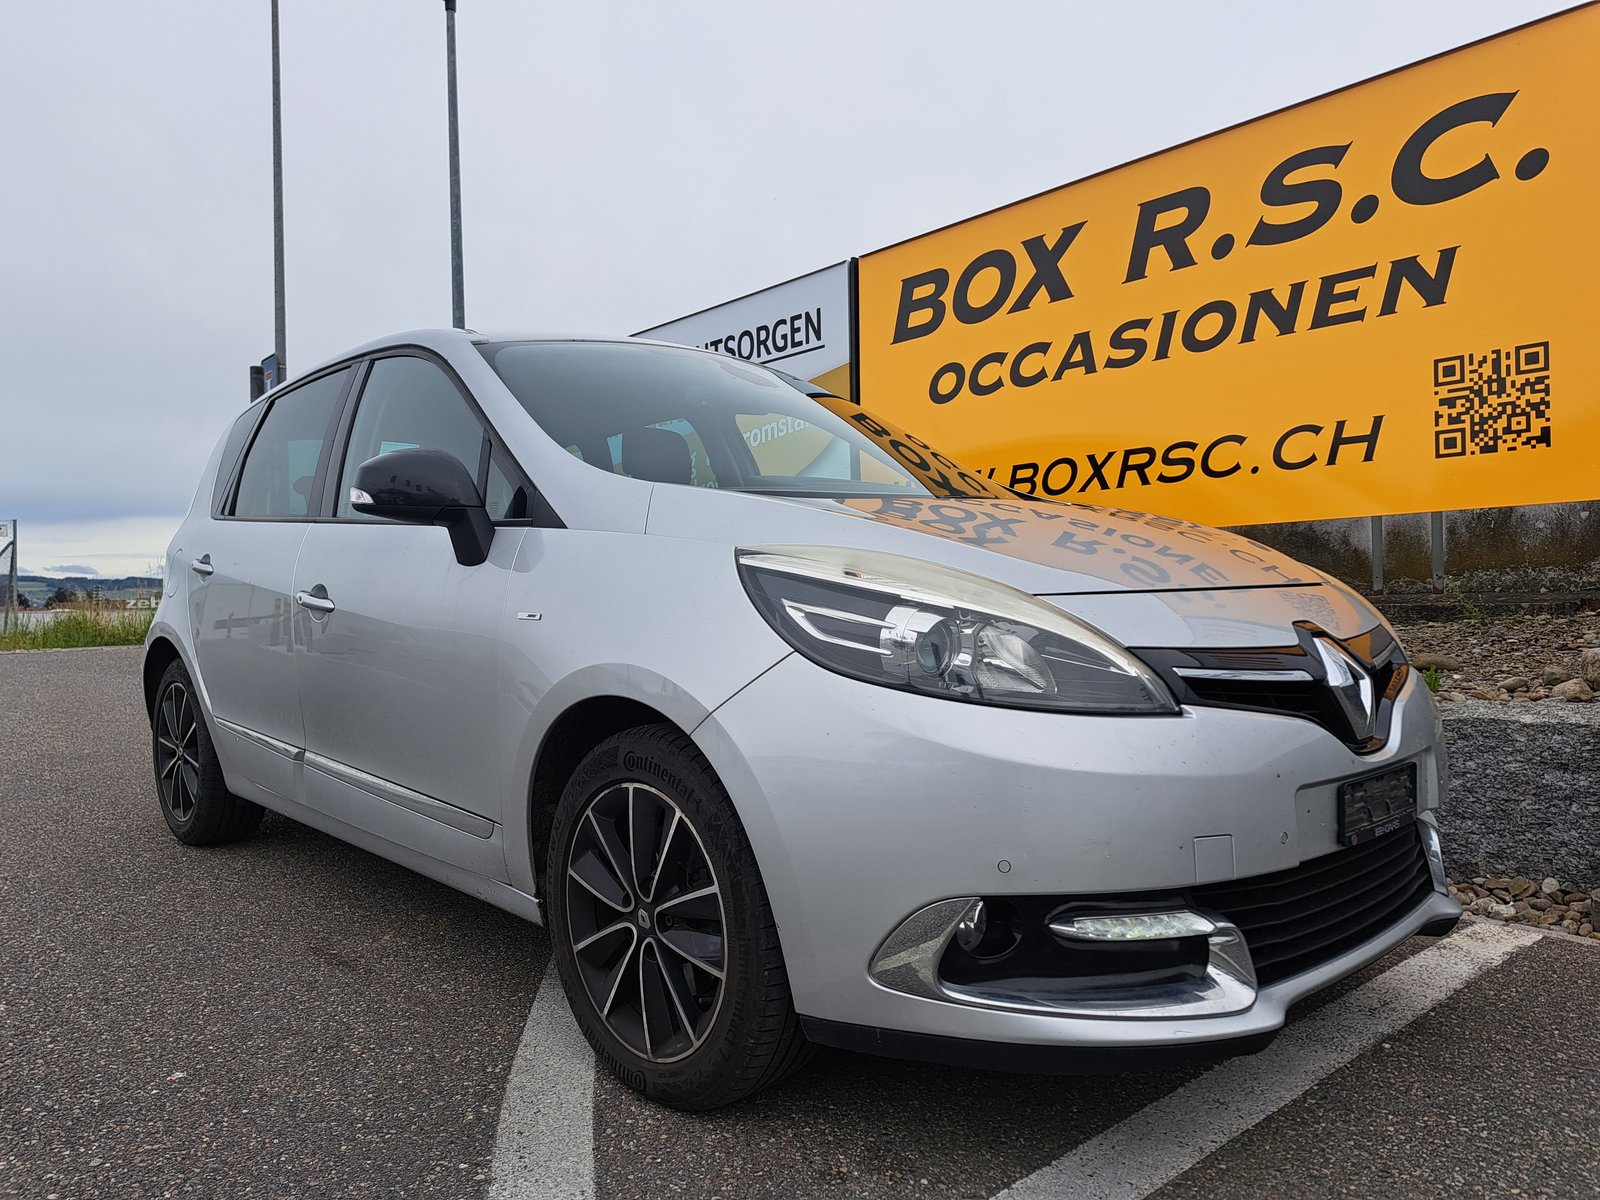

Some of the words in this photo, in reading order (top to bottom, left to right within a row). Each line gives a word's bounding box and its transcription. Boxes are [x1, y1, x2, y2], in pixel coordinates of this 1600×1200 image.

[890, 221, 1088, 345] BOX
[1122, 90, 1549, 285] R.S.C.
[928, 245, 1461, 404] OCCASIONEN
[624, 751, 695, 804] Continental
